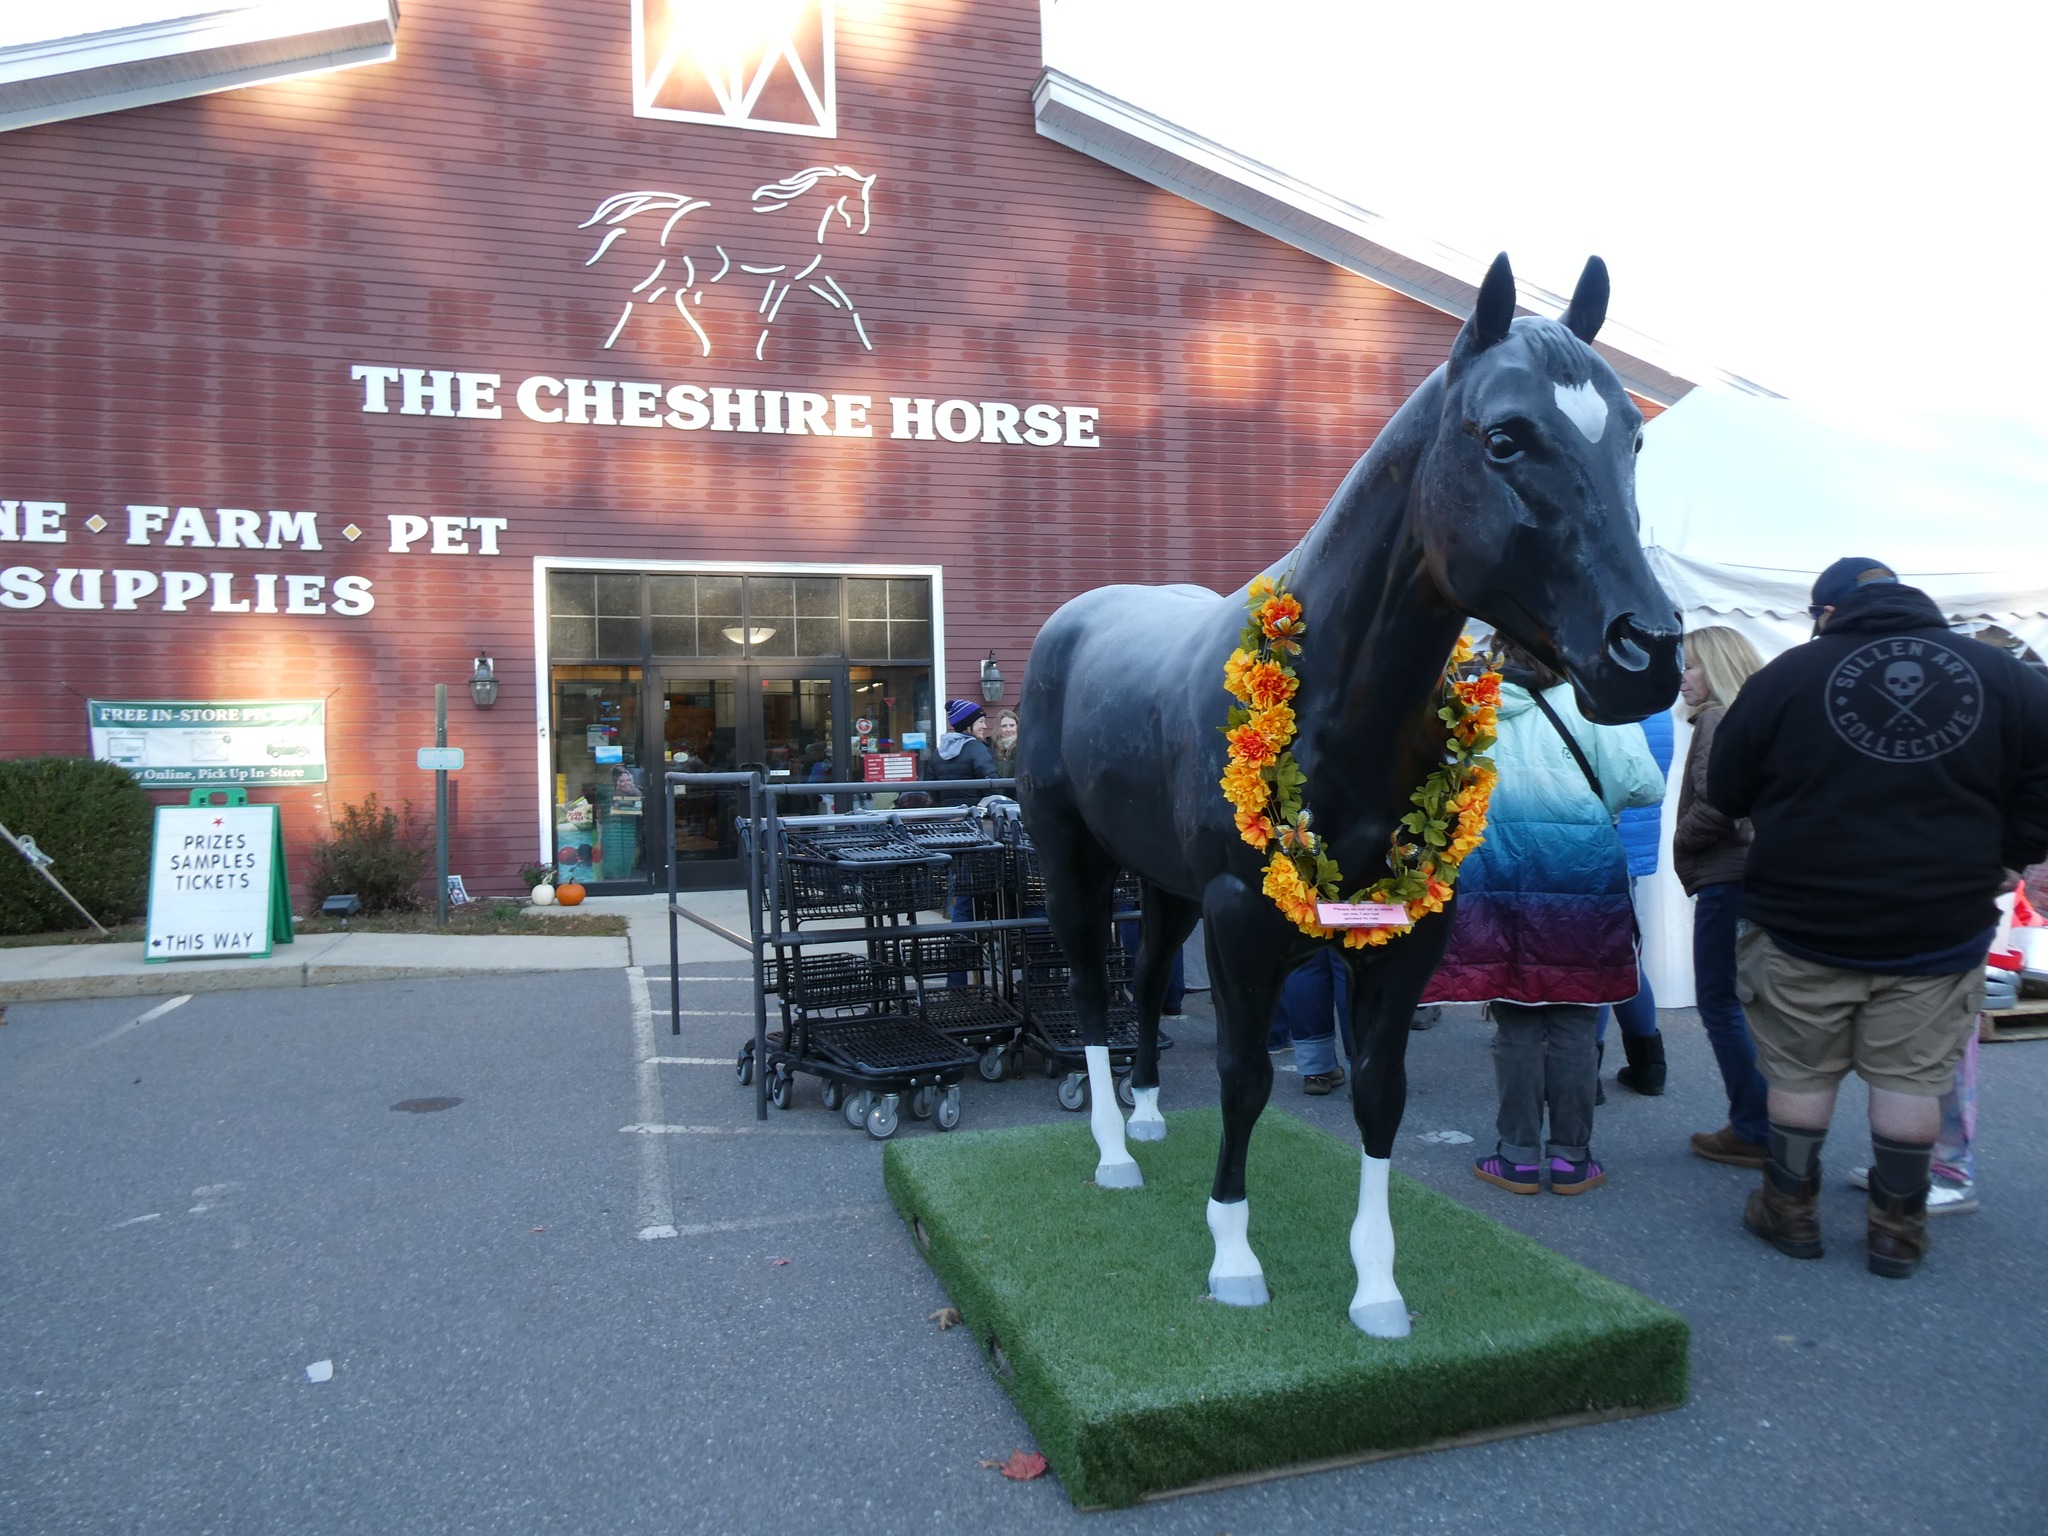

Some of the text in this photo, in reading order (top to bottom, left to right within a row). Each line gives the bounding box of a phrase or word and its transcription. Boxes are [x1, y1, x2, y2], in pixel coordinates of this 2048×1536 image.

[351, 365, 1101, 448] THE CHESHIRE HORSE
[127, 505, 323, 551] FARM
[387, 514, 508, 556] PET
[0, 566, 376, 617] SUPPLIES
[1835, 642, 1974, 688] SULLEN ART
[100, 708, 148, 721] FREE
[151, 708, 240, 721] IN-STORE
[1837, 711, 1973, 757] COLLECTIVE
[143, 769, 197, 781] Online,
[197, 768, 228, 779] Pick
[229, 768, 249, 781] Up
[250, 767, 305, 778] In-Store
[184, 834, 246, 850] PRIZES
[170, 853, 255, 871] SAMPLES
[176, 873, 250, 890] TICKETS
[166, 932, 254, 950] THIS WAY
